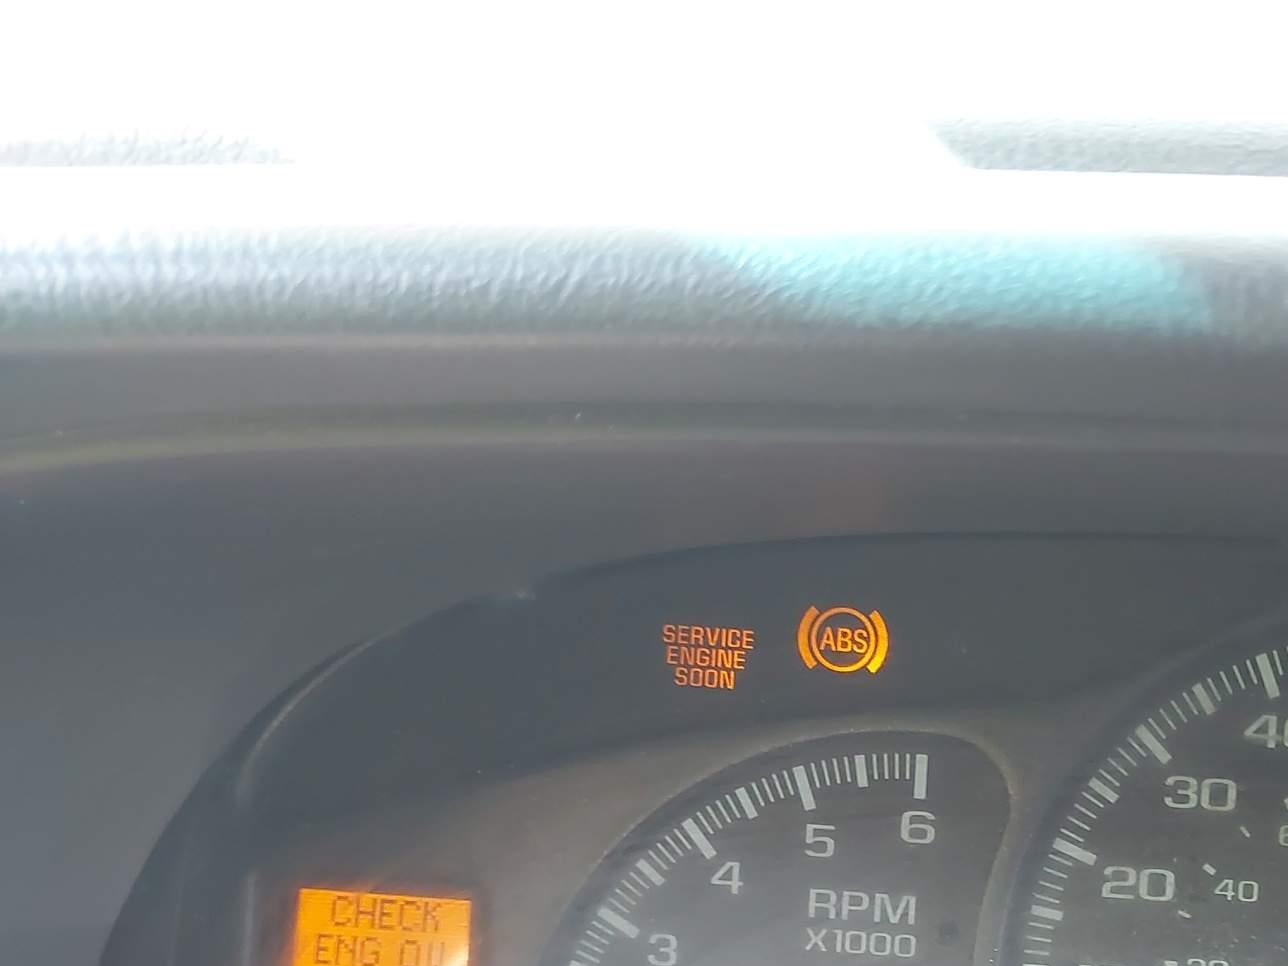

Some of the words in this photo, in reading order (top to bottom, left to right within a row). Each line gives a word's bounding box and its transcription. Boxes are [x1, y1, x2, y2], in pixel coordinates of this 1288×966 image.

[663, 624, 754, 650] SERVICE
[818, 626, 869, 654] ABS
[666, 647, 746, 671] ENGINE
[674, 667, 735, 690] SOON
[1163, 775, 1237, 811] 30
[804, 823, 836, 858] 5
[900, 810, 936, 844] 6
[711, 861, 744, 894] 4
[1101, 866, 1175, 901] 20
[1213, 879, 1259, 902] 40
[330, 895, 443, 932] CHECK
[807, 889, 917, 924] RPM
[647, 934, 679, 966] 3
[805, 928, 917, 957] X1000
